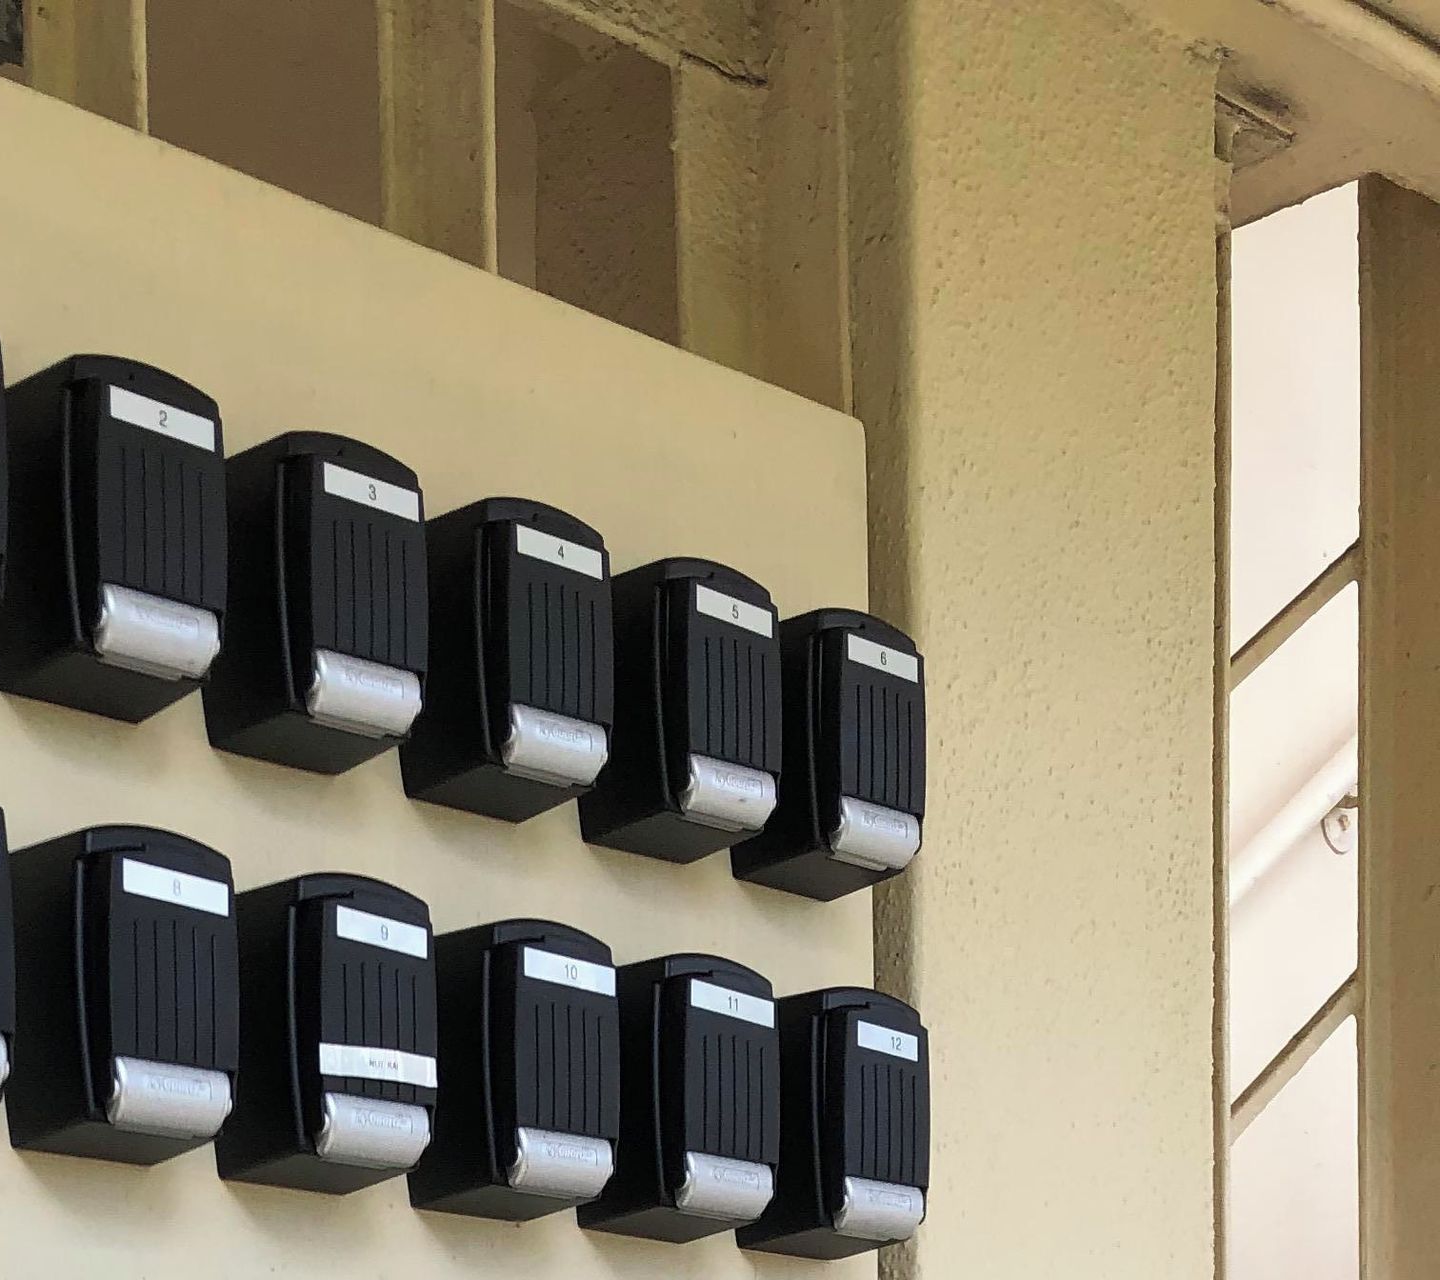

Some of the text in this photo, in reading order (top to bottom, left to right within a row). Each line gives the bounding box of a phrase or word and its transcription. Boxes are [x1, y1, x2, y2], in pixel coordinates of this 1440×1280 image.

[158, 409, 168, 429] 2
[368, 483, 377, 501] 3
[557, 544, 565, 560] 4
[731, 603, 739, 620] 5
[880, 651, 888, 666] 6
[380, 923, 389, 941] 9
[564, 963, 578, 981] 10
[728, 995, 739, 1012] 11
[890, 1036, 903, 1052] 12
